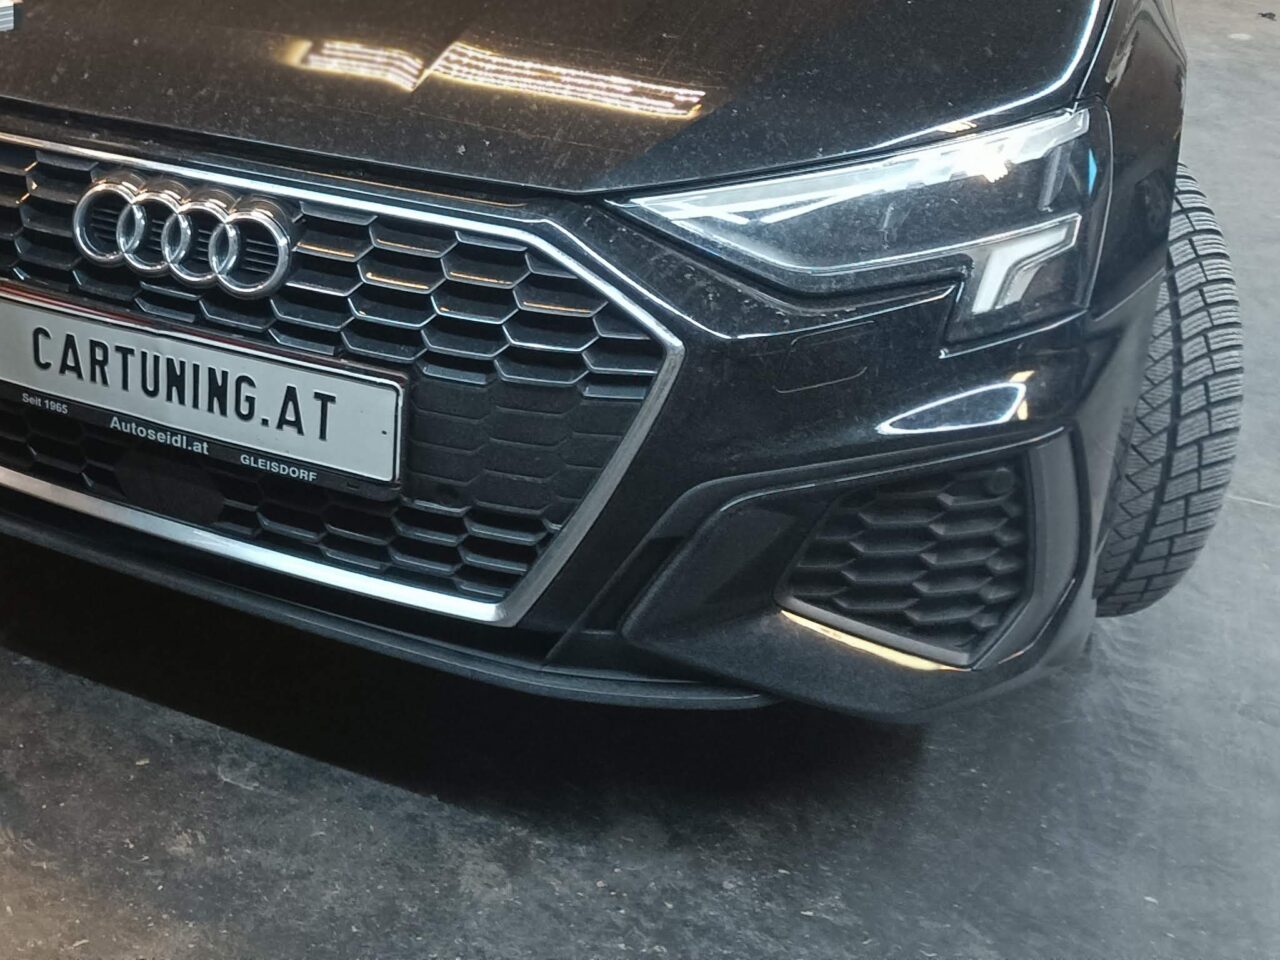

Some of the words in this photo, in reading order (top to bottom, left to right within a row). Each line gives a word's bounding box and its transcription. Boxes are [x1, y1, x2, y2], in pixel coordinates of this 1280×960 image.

[32, 326, 337, 441] CARTUNING.AT
[21, 392, 42, 407] Seit
[44, 399, 69, 414] 1965
[110, 416, 209, 455] Autoseidl.at
[239, 454, 318, 482] GLEISDORF
